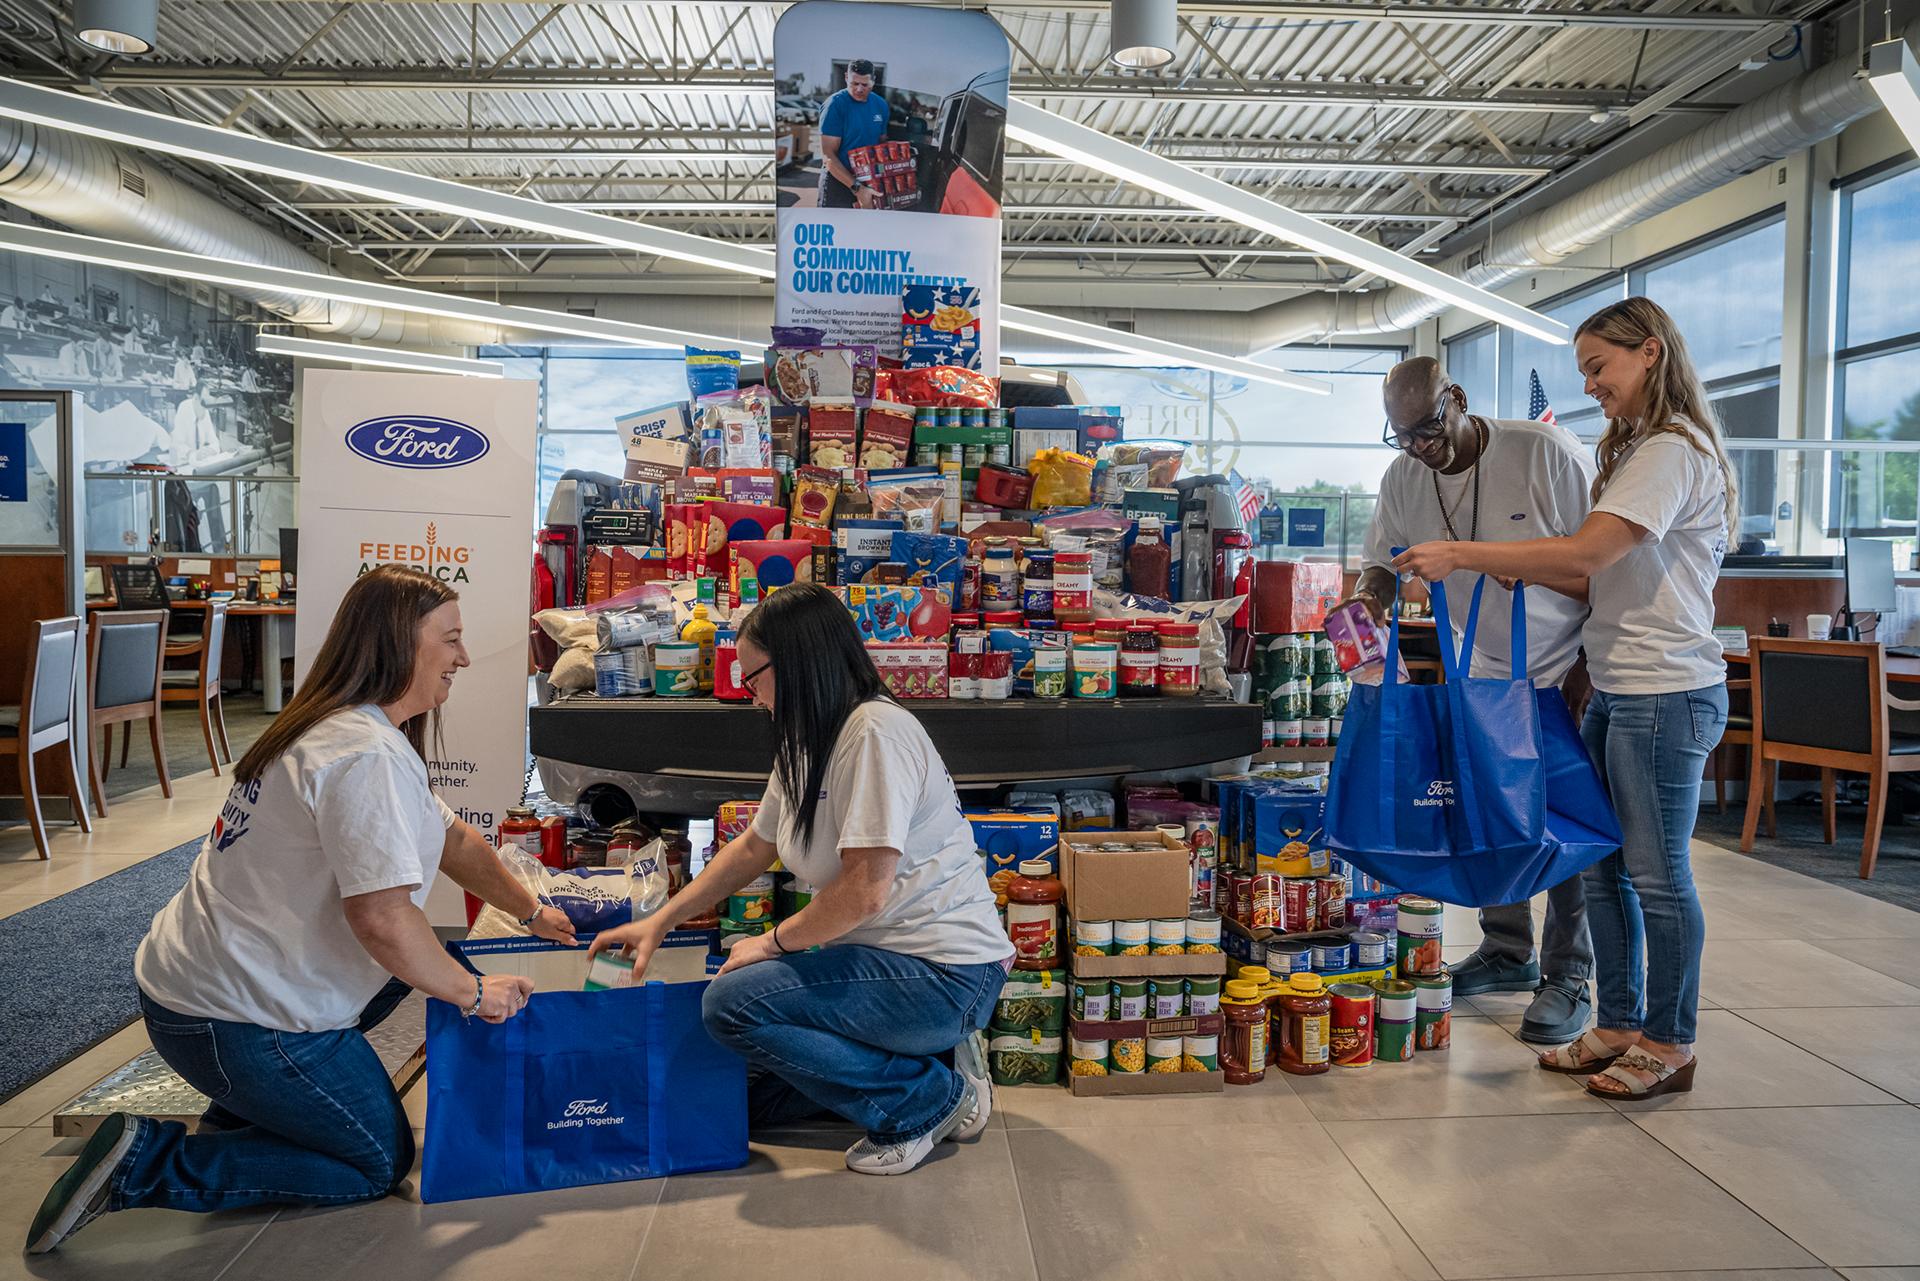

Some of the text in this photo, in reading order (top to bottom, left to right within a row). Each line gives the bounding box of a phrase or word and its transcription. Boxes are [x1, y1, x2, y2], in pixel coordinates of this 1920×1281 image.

[794, 224, 834, 246] OUR
[793, 247, 914, 273] COMMUNITY.
[793, 271, 833, 293] OUR
[792, 307, 804, 315] Ford
[870, 311, 890, 319] always
[852, 339, 878, 347] prepared
[633, 420, 666, 436] CRISP
[1118, 418, 1122, 426] 6
[375, 423, 461, 460] Ford
[1126, 510, 1167, 520] BETTER
[949, 538, 956, 548] 5
[360, 542, 469, 563] FEEDING
[1324, 598, 1328, 608] 6
[1413, 798, 1443, 807] Building
[1040, 826, 1052, 834] 12
[564, 1099, 608, 1117] Ford
[547, 1116, 624, 1130] Building Together
